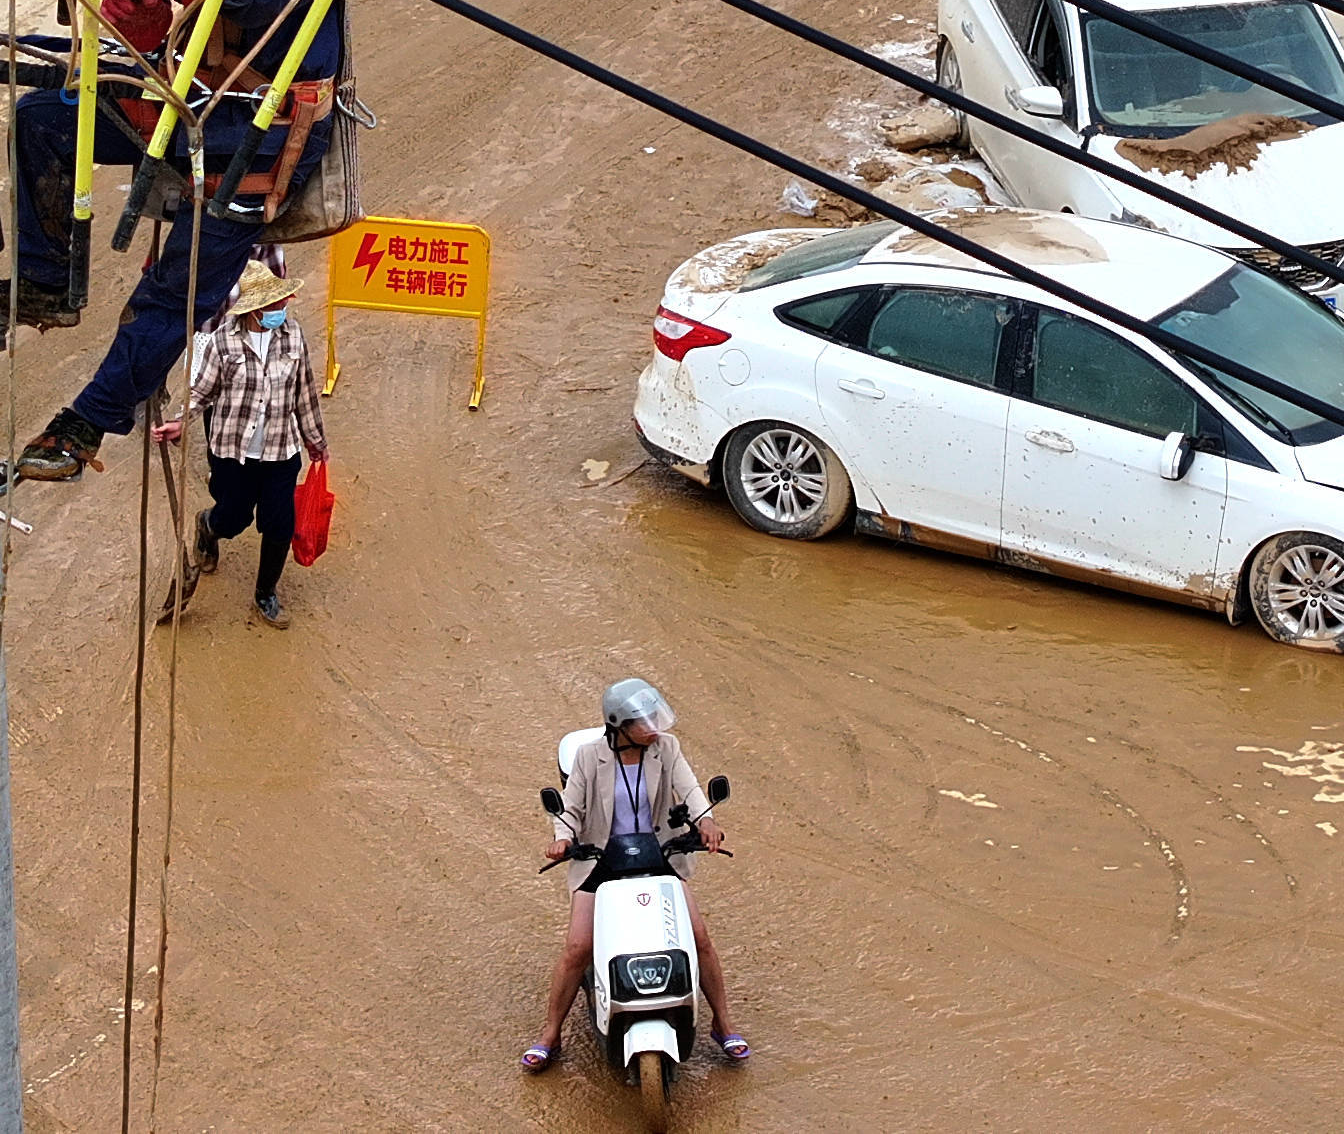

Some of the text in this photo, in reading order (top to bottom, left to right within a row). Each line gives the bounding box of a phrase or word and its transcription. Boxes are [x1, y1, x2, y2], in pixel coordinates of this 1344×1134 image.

[388, 235, 469, 265] 电力施工
[386, 267, 468, 298] 车辆慢行
